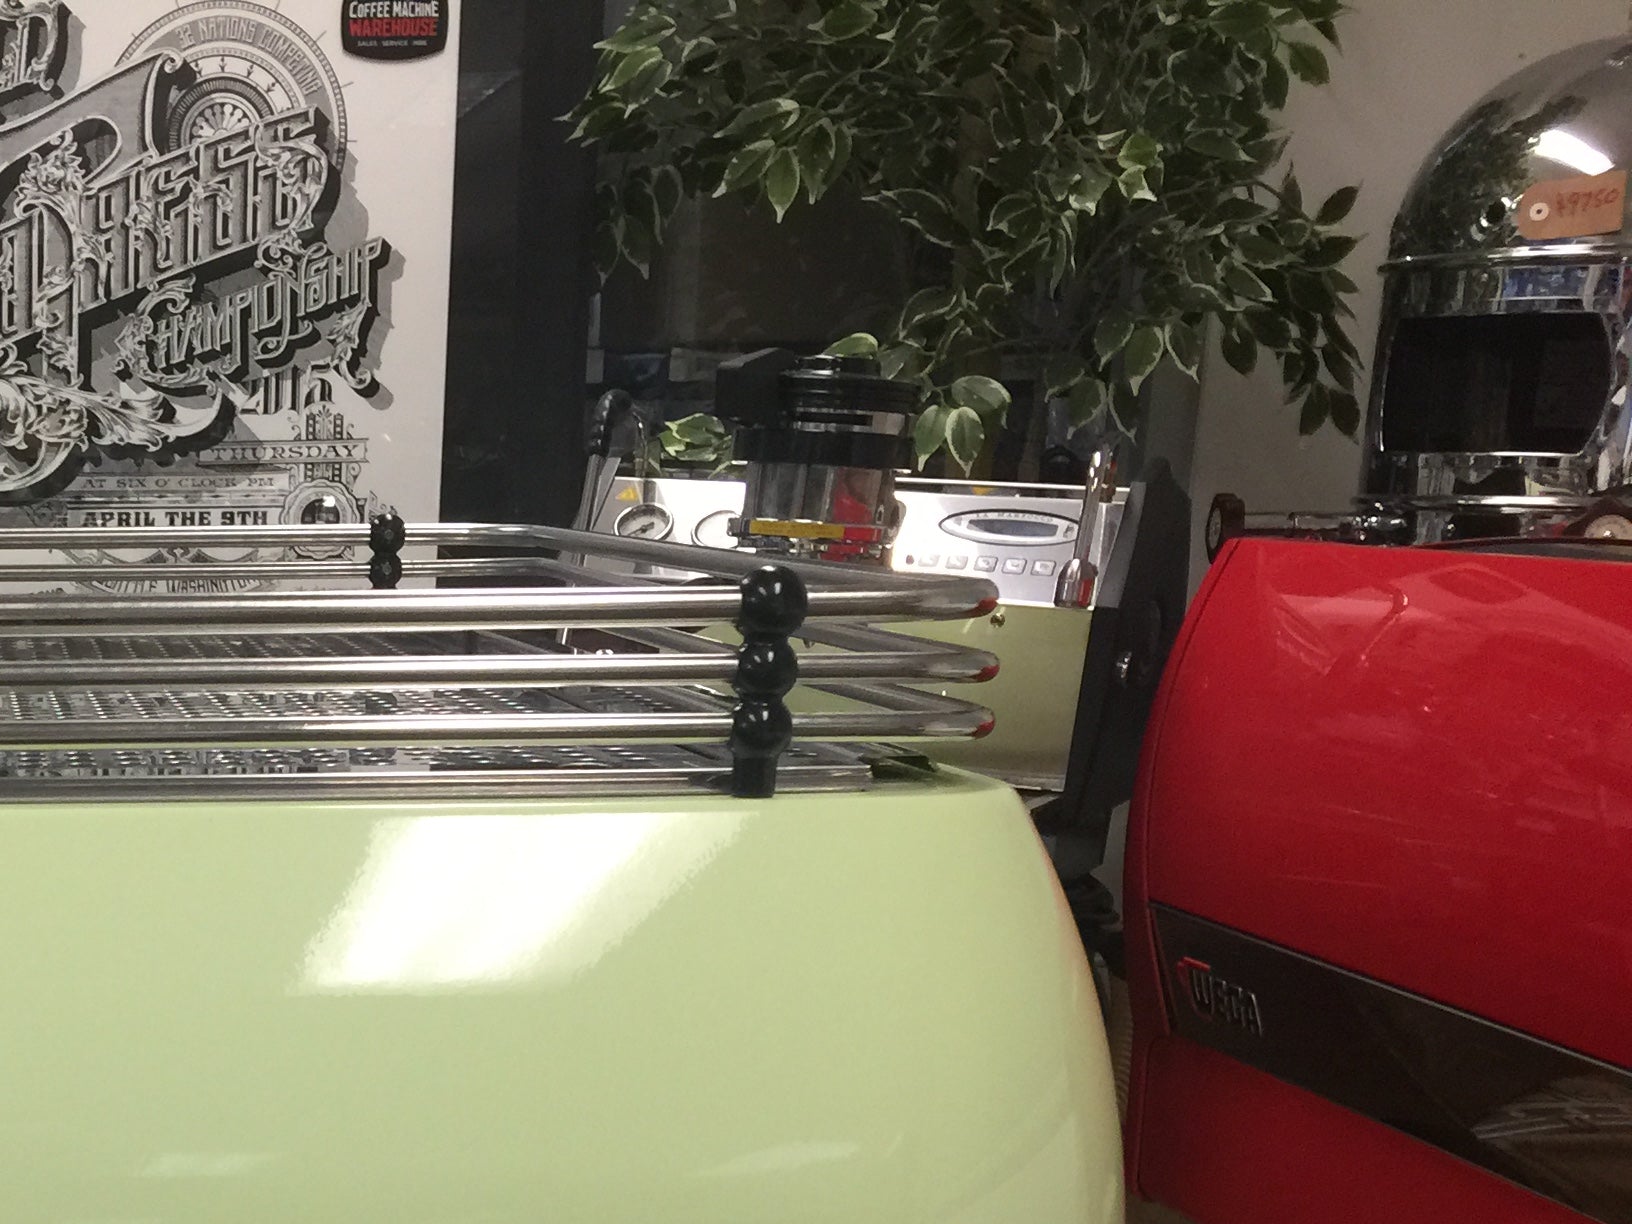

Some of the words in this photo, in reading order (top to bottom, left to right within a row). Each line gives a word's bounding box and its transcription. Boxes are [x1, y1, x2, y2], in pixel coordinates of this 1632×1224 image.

[349, 1, 390, 18] COFFEE
[392, 0, 439, 17] MACHINE
[349, 19, 437, 37] WAREHOUSE
[198, 16, 256, 43] NATIONS
[258, 28, 323, 96] COMPETING
[114, 234, 384, 395] CHAMPIONSHIP
[210, 444, 359, 460] THURSDAY
[82, 478, 105, 489] AT
[116, 478, 147, 489] SIX
[177, 478, 238, 489] CLOCK
[82, 510, 156, 527] APRIL
[164, 510, 212, 527] THE
[220, 510, 269, 527] 9TH
[1189, 964, 1263, 1038] WEGA
